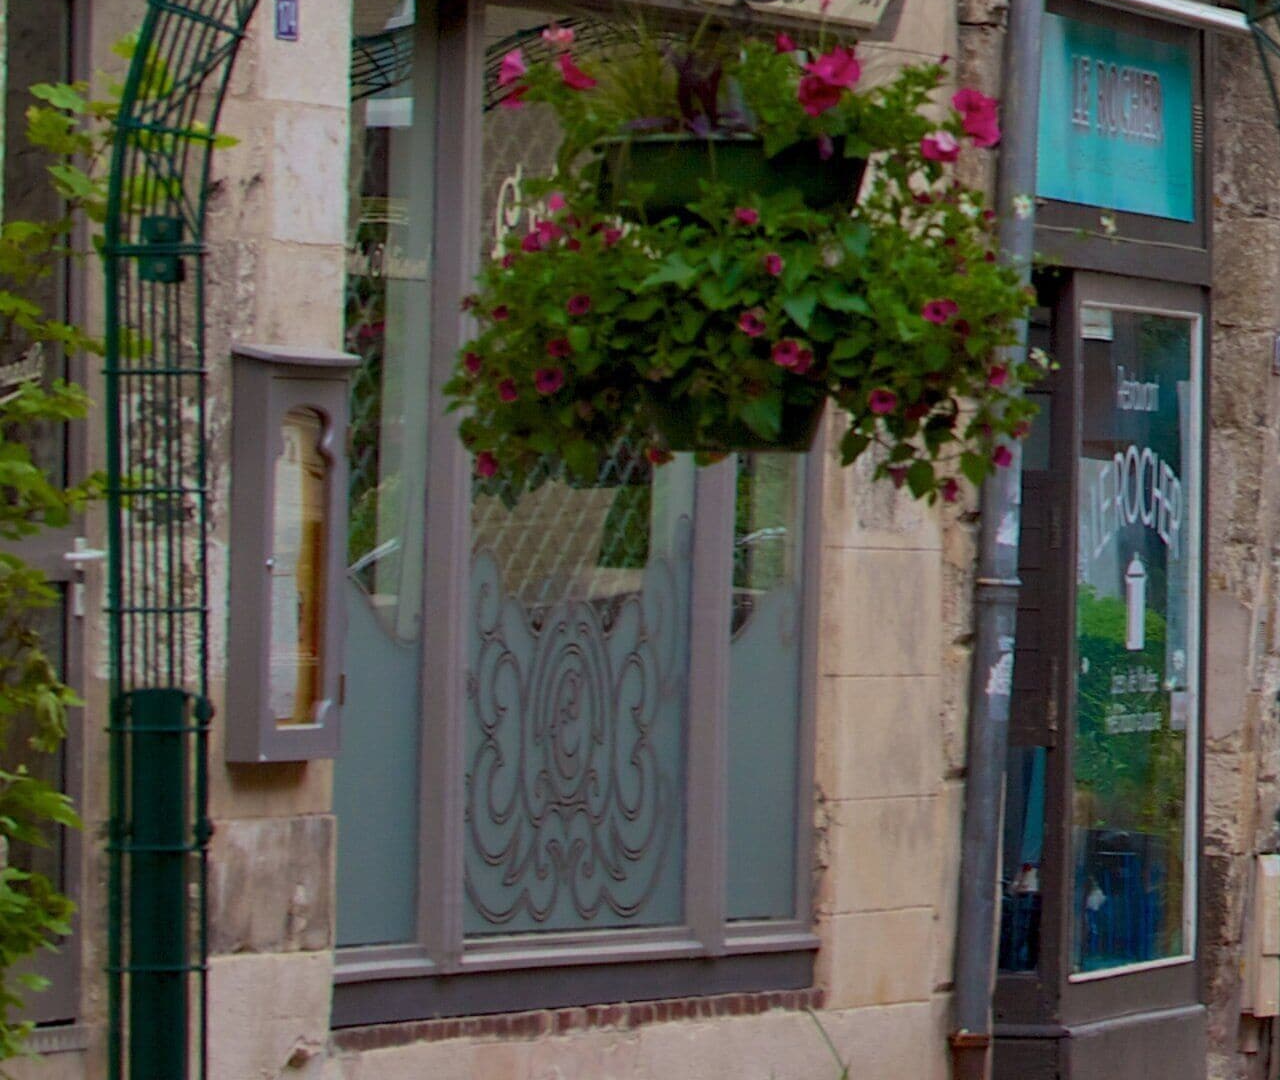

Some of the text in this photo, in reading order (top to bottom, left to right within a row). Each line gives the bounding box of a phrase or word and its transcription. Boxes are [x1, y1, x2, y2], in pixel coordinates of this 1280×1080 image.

[1071, 54, 1163, 143] LE ROCHER
[1114, 445, 1183, 560] ROCHER
